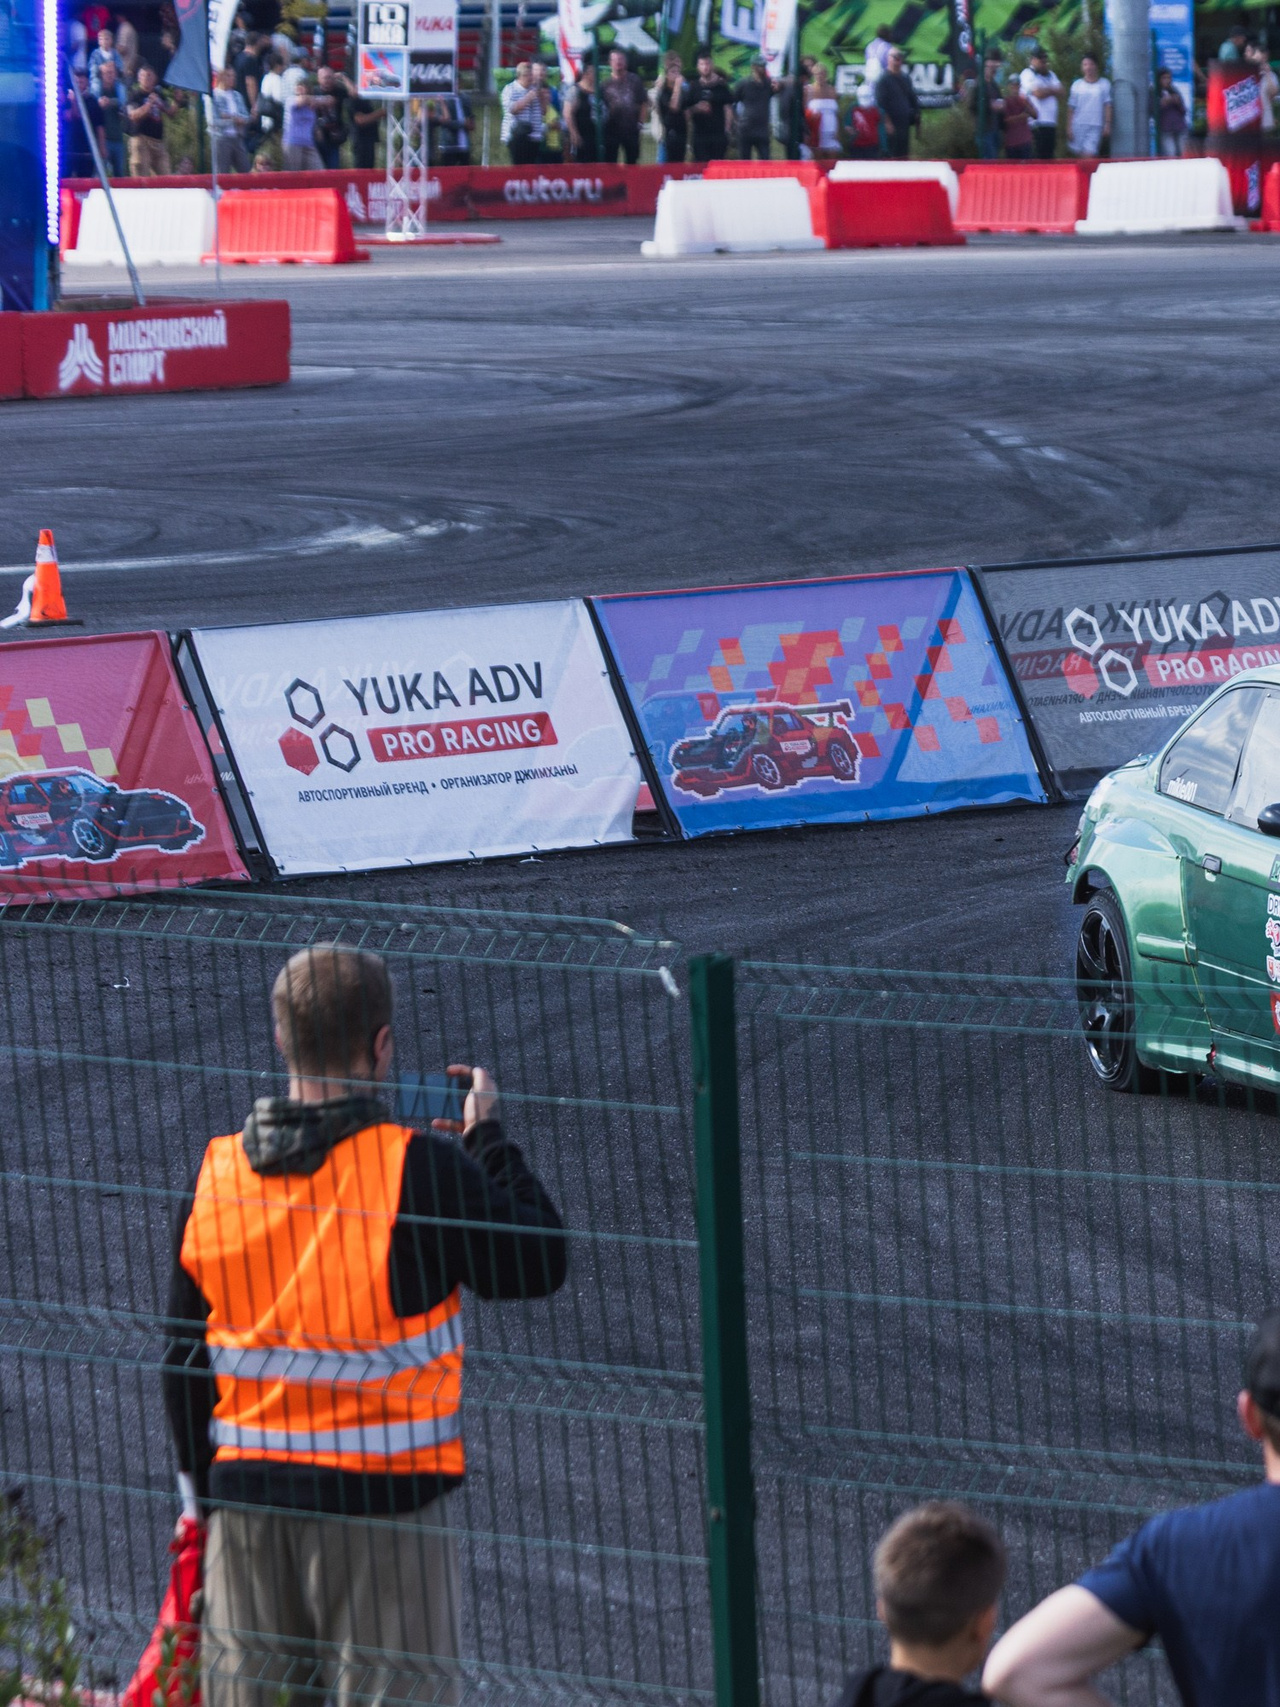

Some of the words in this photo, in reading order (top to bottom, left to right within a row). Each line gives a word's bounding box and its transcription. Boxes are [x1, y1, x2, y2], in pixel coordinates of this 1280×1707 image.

[1117, 602, 1228, 644] YUKA
[342, 670, 461, 716] YUKA
[468, 661, 543, 706] ADV
[1156, 657, 1205, 683] PRO
[1079, 704, 1168, 723] АВТОСПОРТИВНЫЙ
[382, 728, 436, 756] PRO
[443, 718, 541, 750] RACING
[298, 781, 393, 802] АВТОСПОРТИВНЫЙ
[392, 780, 429, 795] БРЕНД
[441, 772, 513, 790] ОРГАНИЗАТОР
[515, 763, 579, 784] ДЖИМХАНЫ
